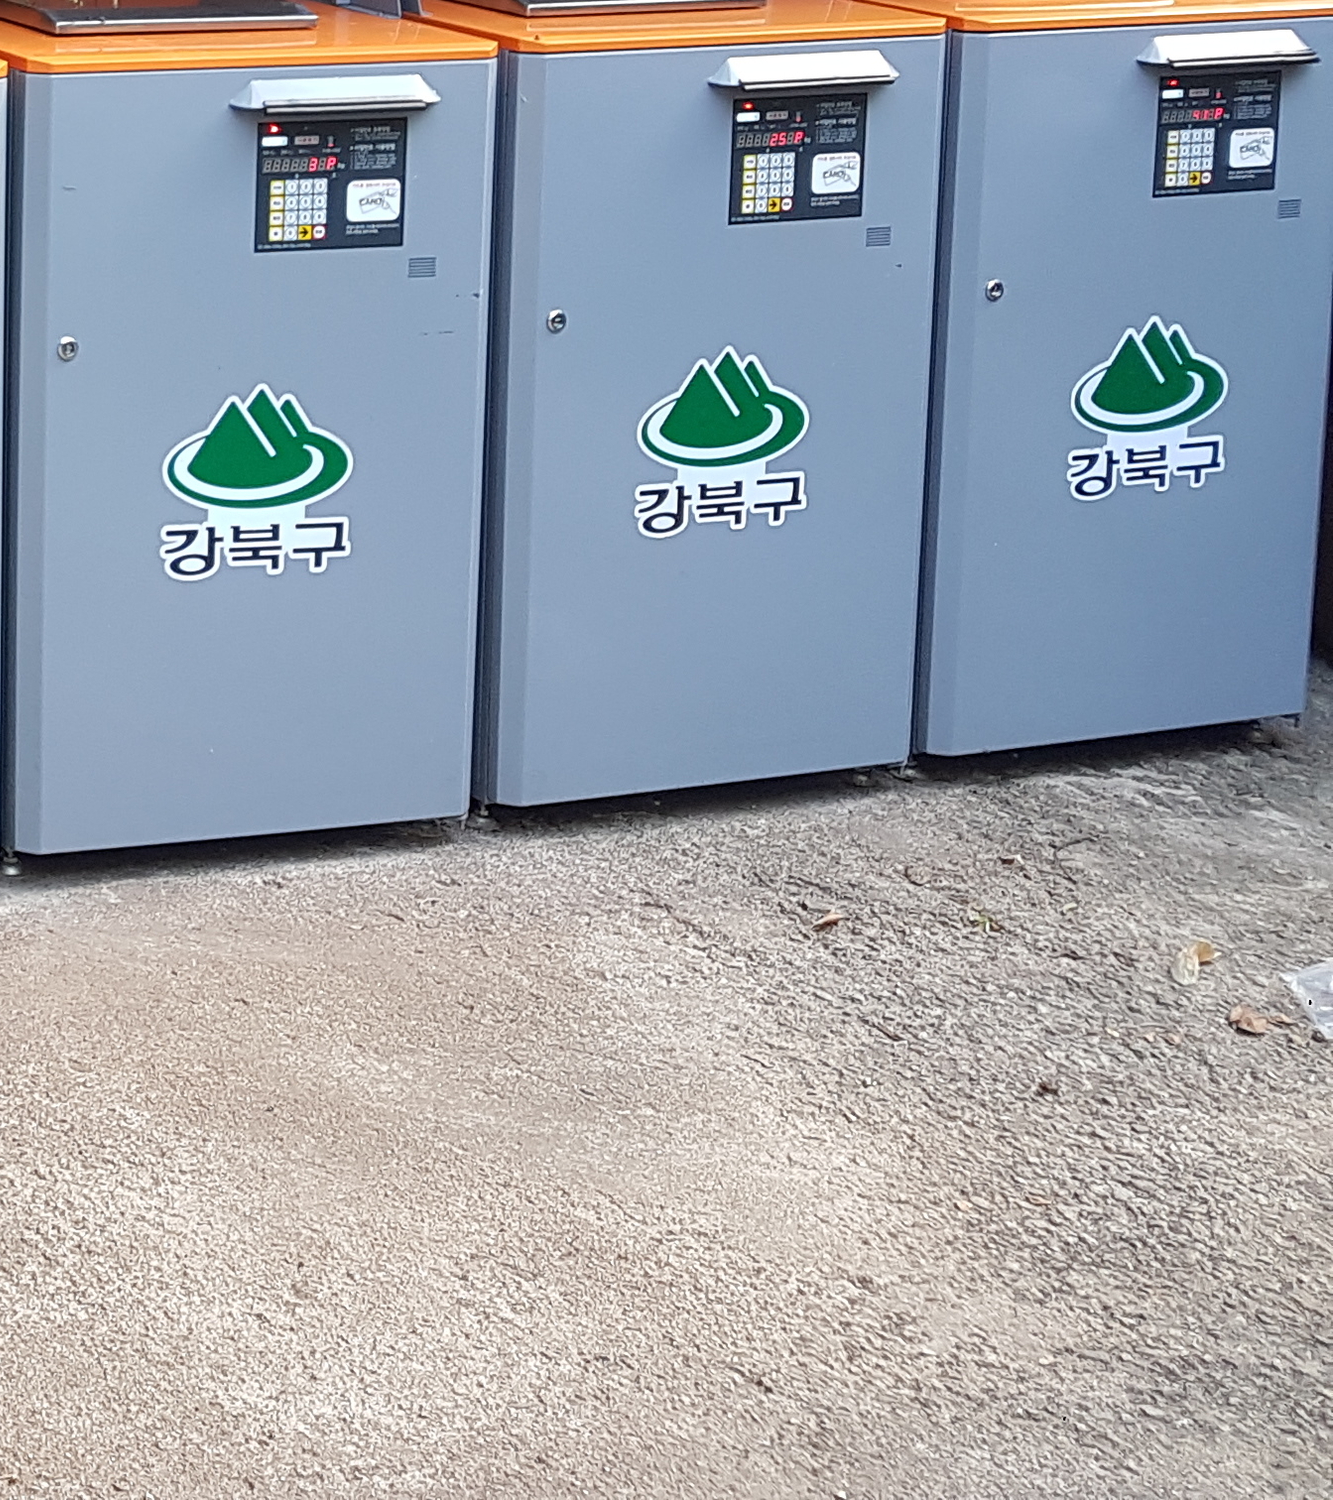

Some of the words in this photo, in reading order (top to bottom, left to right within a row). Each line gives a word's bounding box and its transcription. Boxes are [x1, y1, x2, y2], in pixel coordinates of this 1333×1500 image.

[1071, 441, 1221, 498] 강북구
[638, 477, 802, 534] 강북구
[165, 522, 345, 577] 강북구
